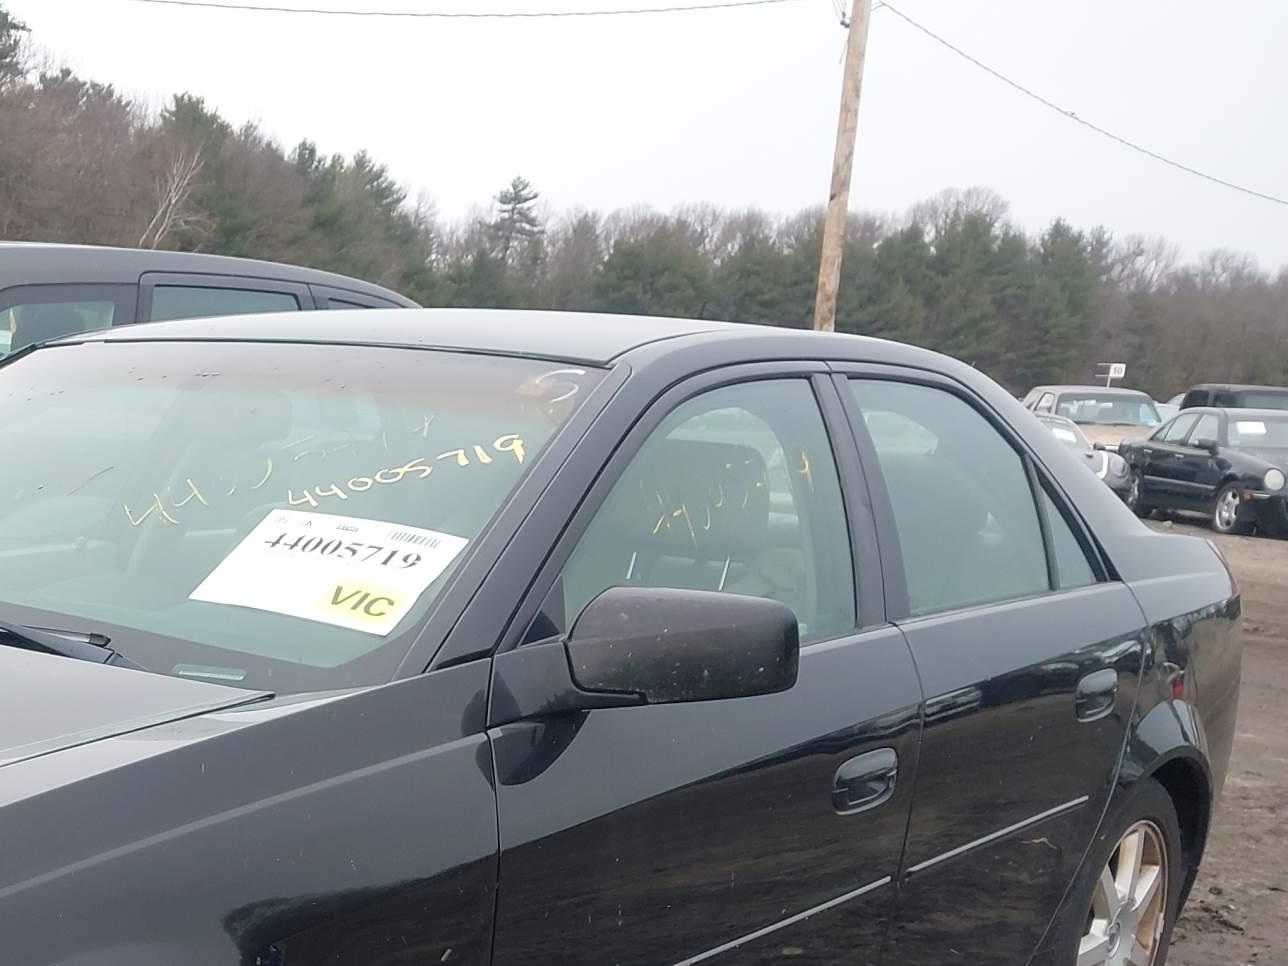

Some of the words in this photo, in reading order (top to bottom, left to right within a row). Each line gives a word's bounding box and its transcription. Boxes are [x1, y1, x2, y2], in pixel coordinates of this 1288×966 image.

[287, 434, 526, 508] 44005719
[264, 532, 422, 569] 44005719
[330, 585, 395, 617] VIC
